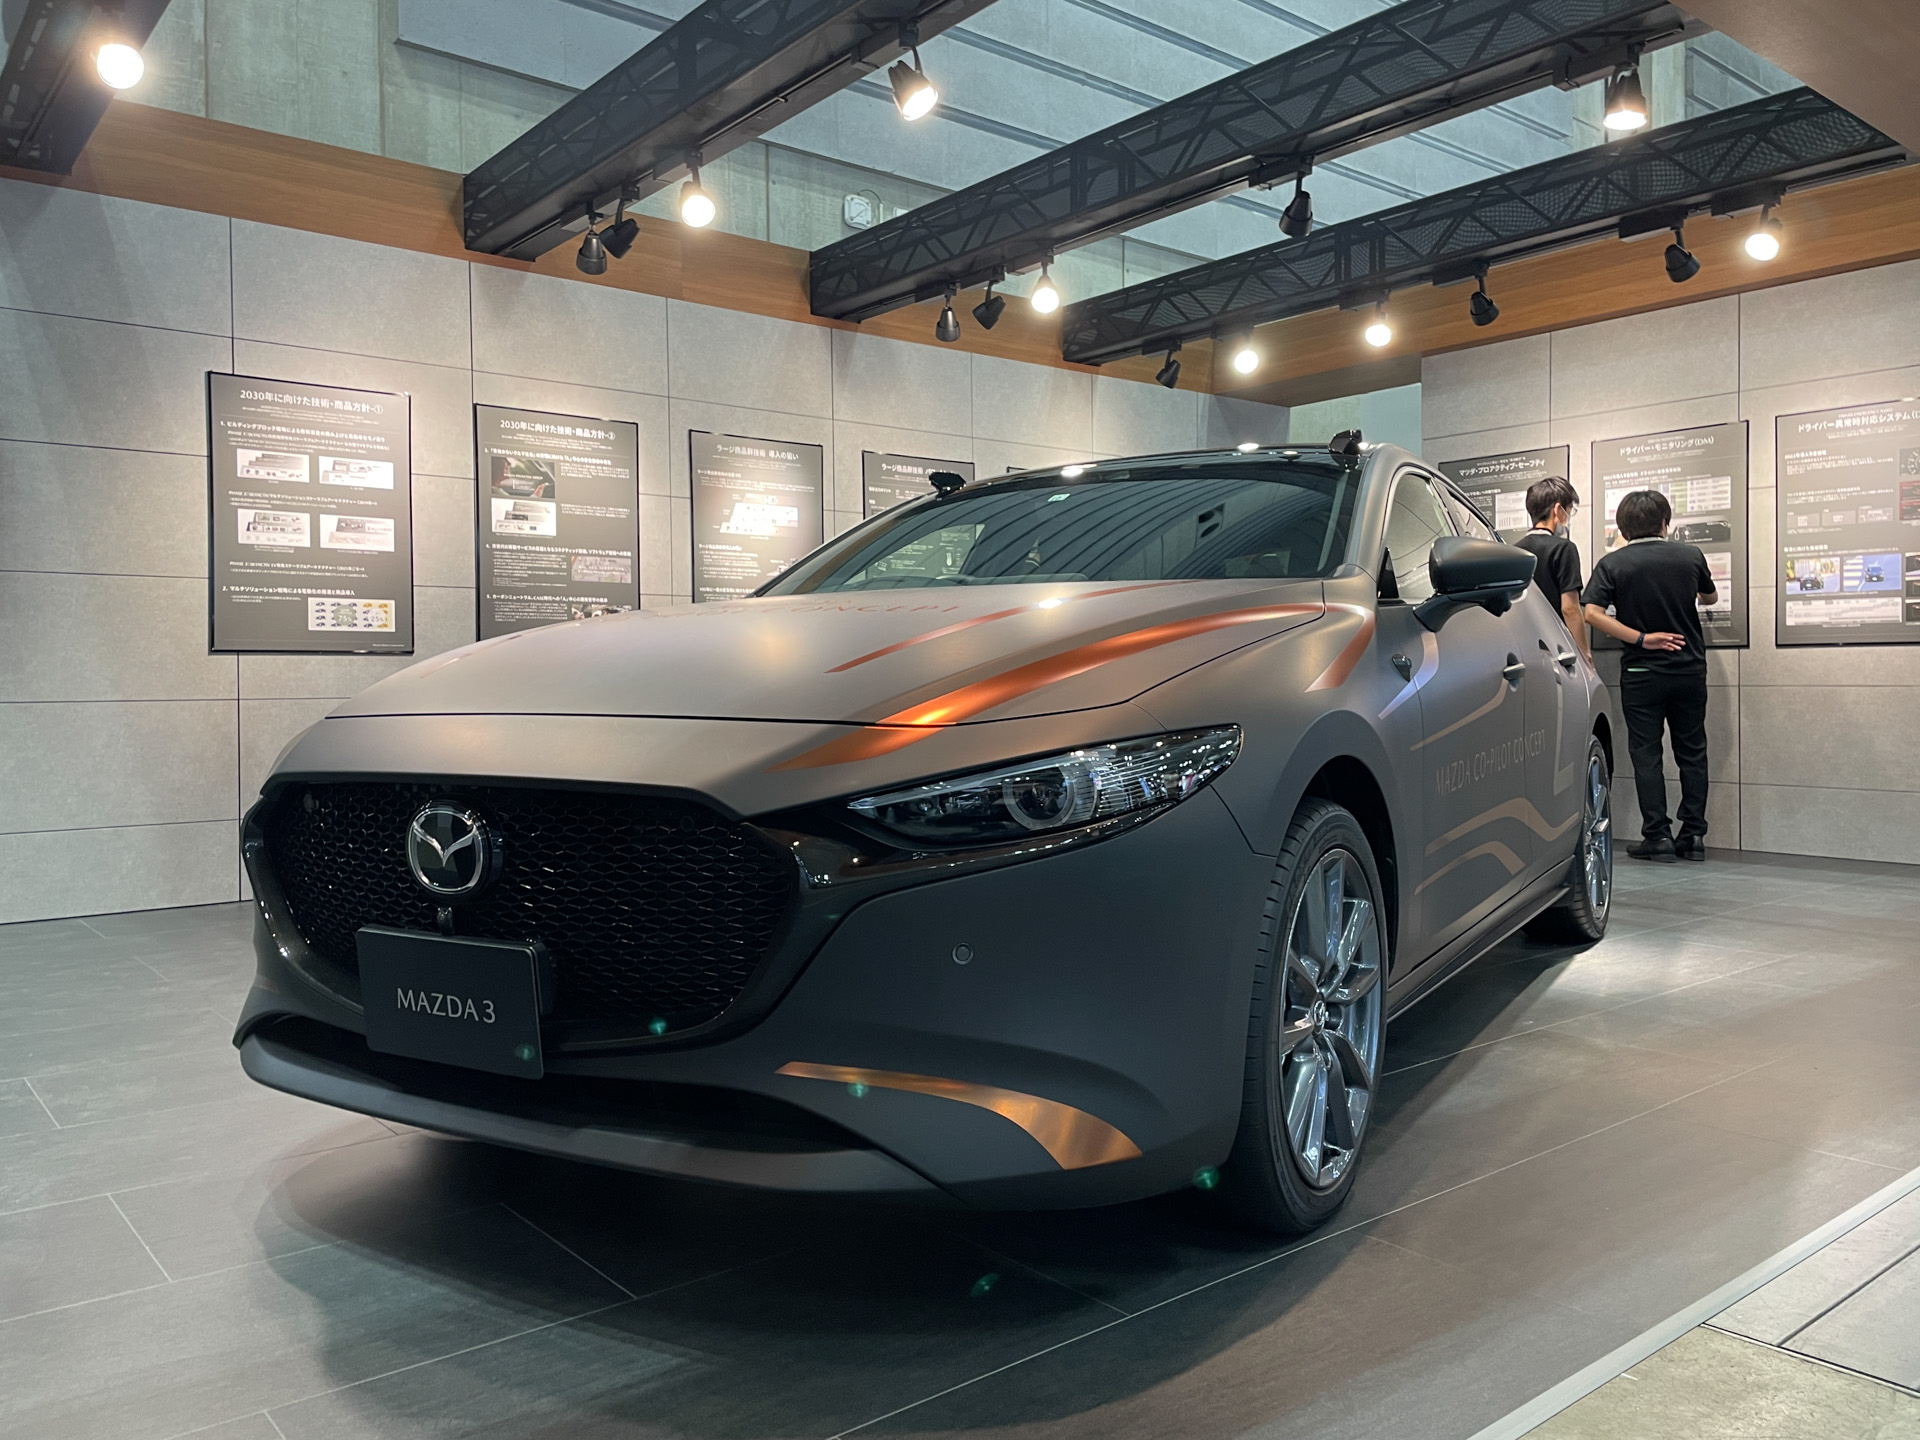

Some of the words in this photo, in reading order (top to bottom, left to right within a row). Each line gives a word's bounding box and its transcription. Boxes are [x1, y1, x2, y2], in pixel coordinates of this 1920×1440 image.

[1436, 758, 1471, 797] MAZDA
[1473, 741, 1512, 781] CO-PILOT
[1513, 729, 1546, 764] CONCEPT
